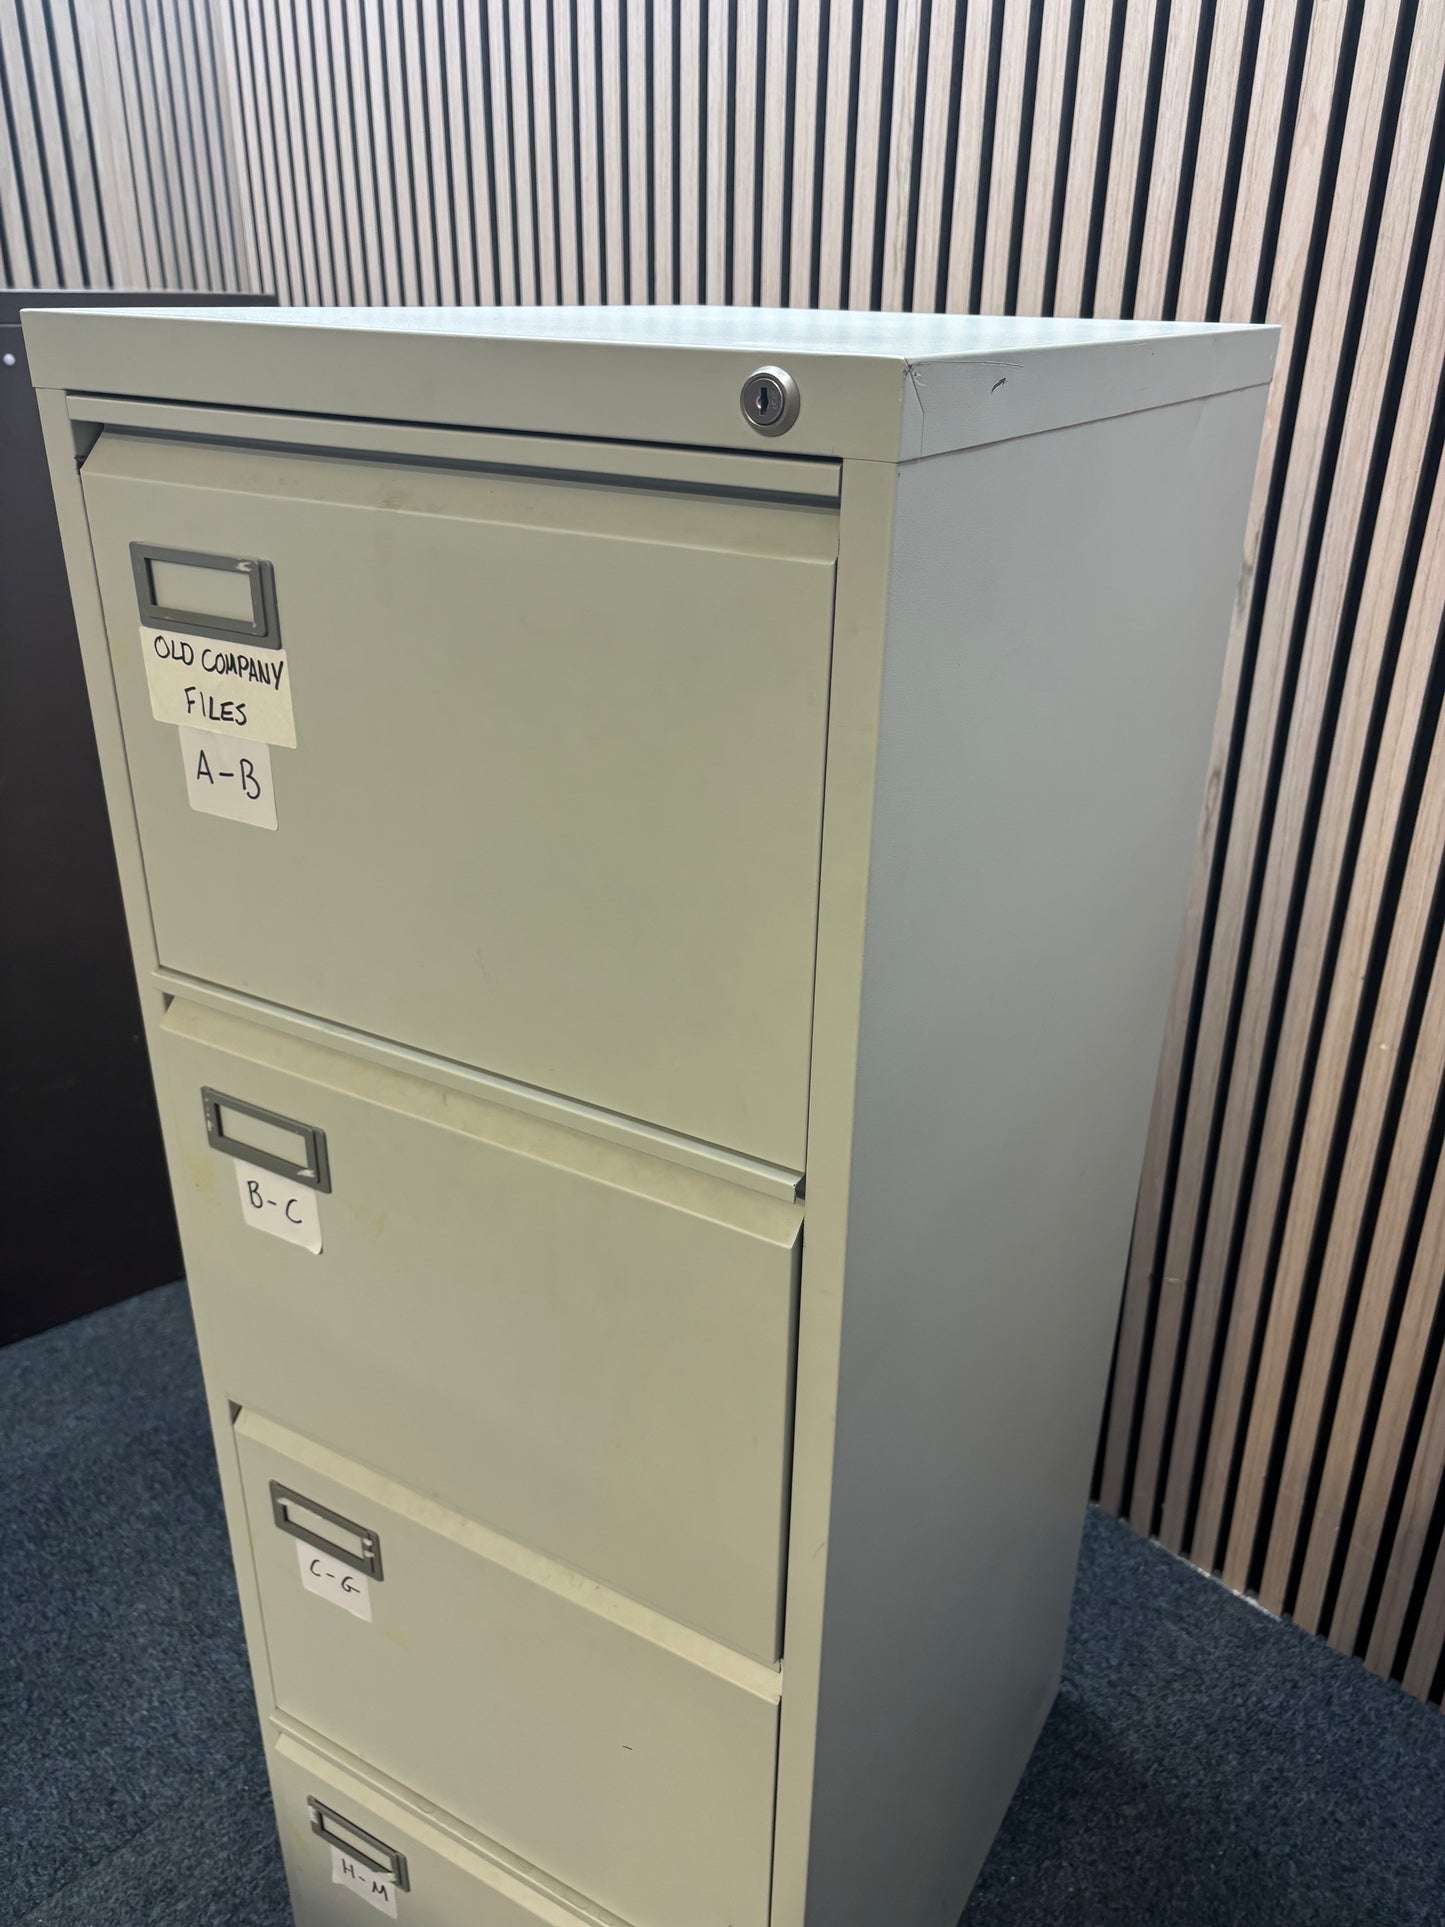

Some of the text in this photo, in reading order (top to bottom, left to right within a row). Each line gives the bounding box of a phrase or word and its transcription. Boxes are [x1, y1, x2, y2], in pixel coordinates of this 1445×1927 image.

[154, 635, 284, 690] OLD COMPANY
[184, 686, 247, 726] FILES
